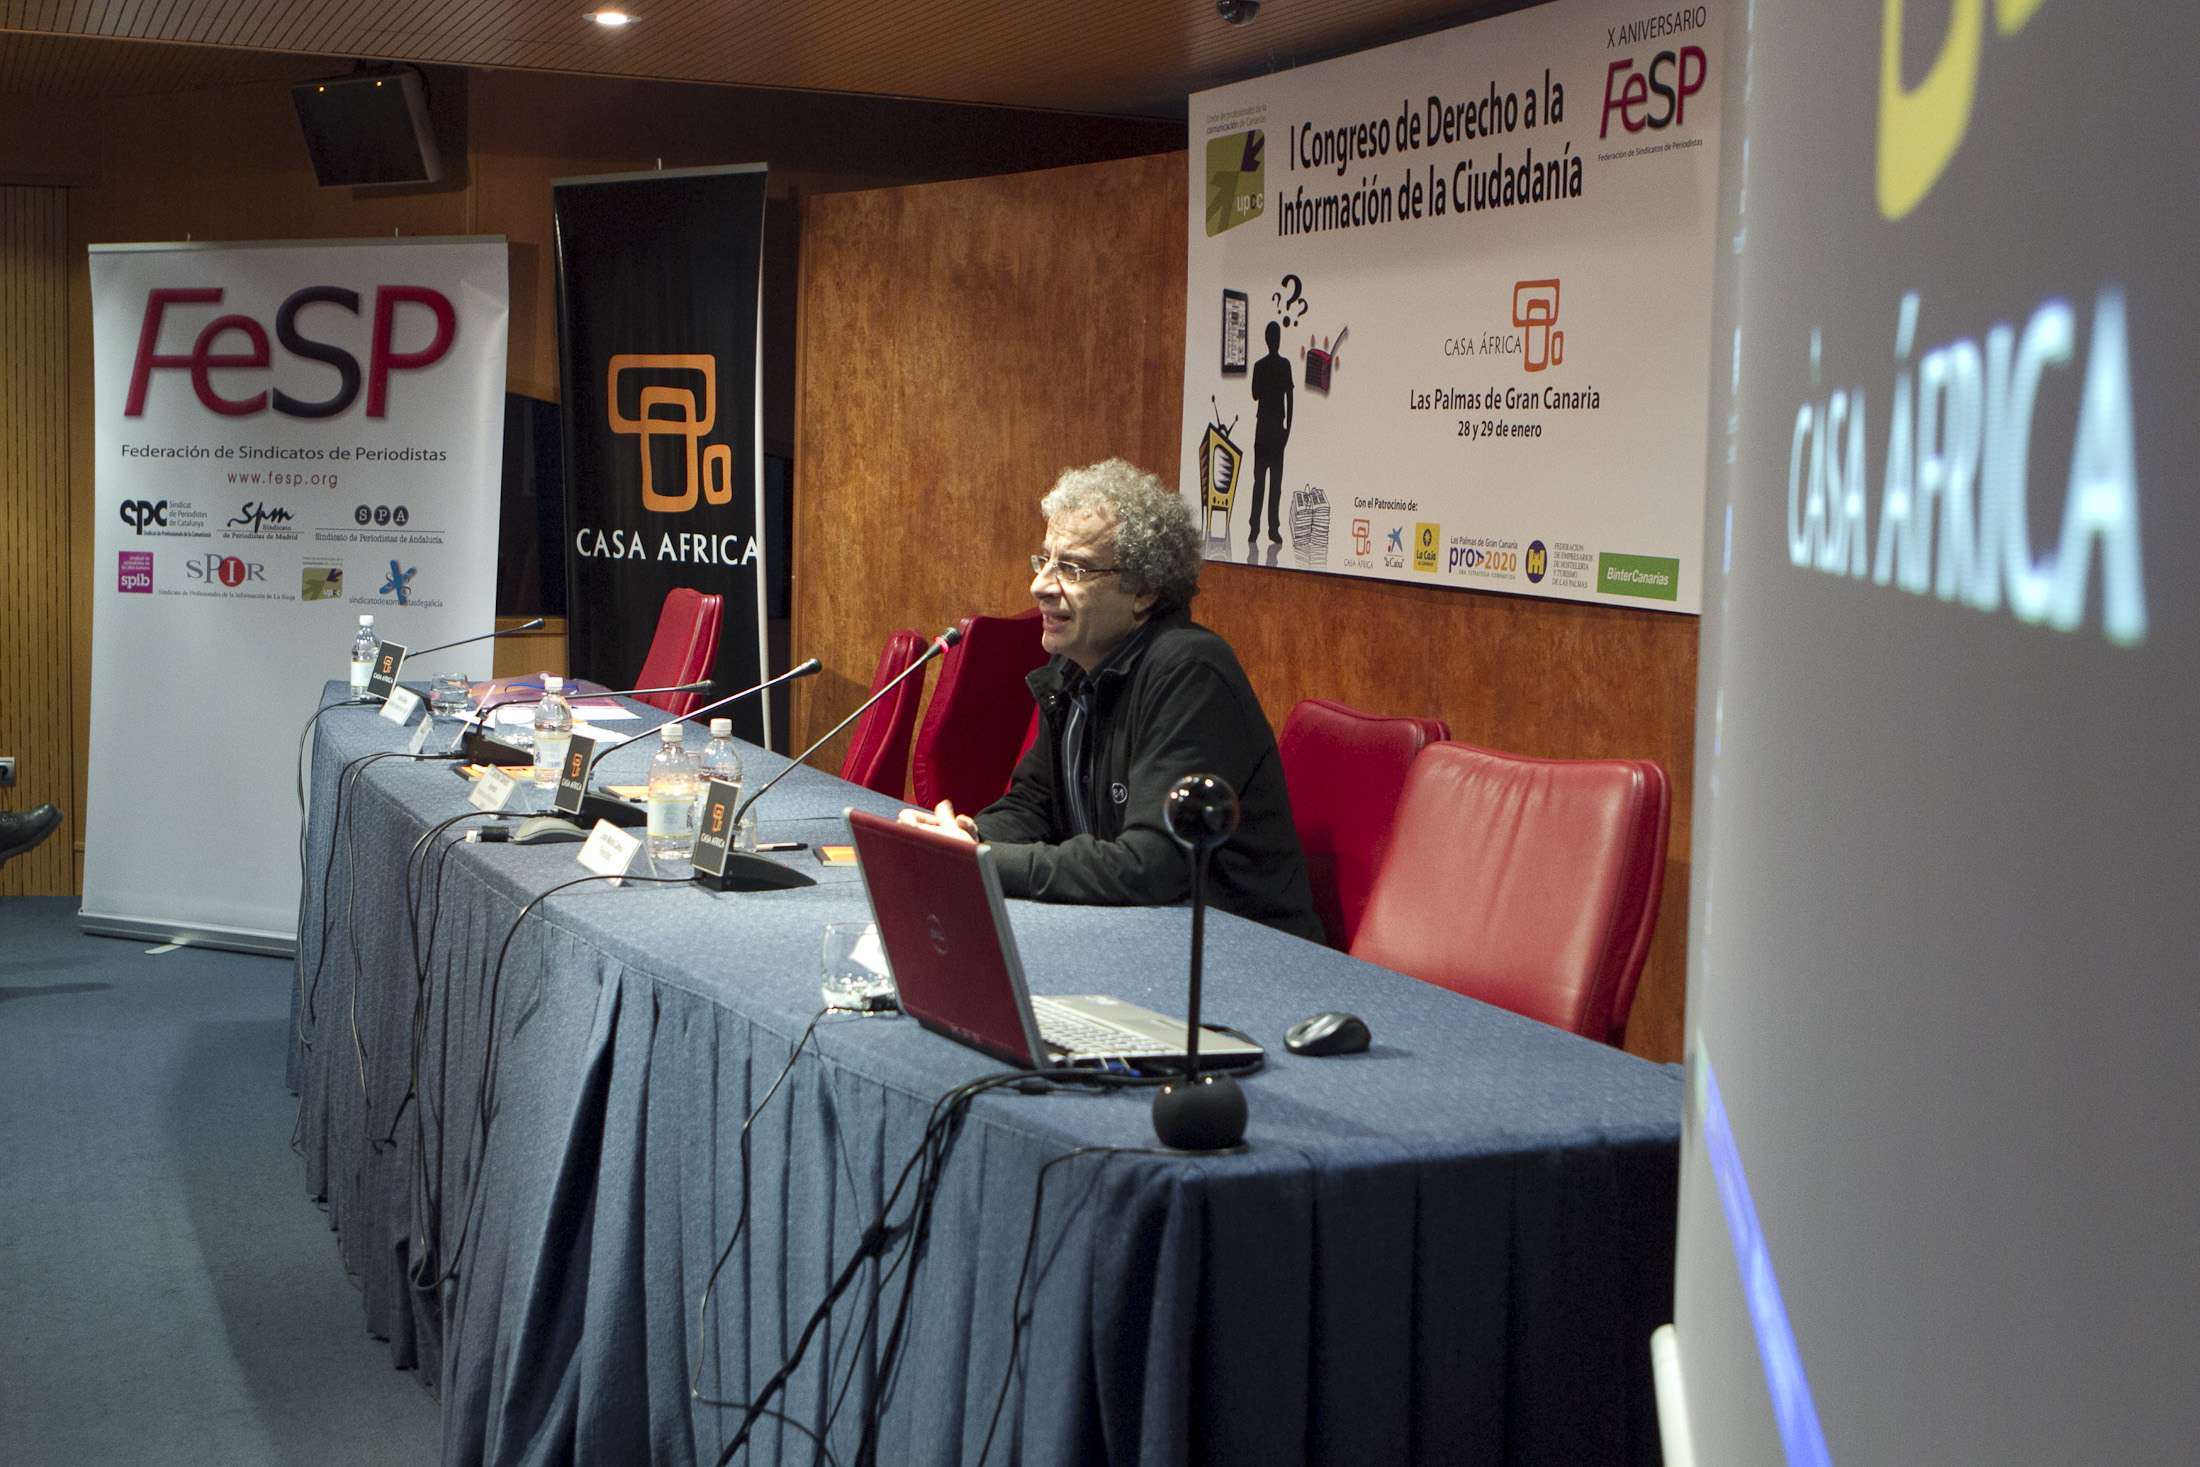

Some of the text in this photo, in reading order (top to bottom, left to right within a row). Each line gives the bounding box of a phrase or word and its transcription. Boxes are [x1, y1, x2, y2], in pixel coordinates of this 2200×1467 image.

[1606, 6, 1707, 48] X ANIVERSARIO
[1599, 45, 1707, 139] FeSP
[1290, 68, 1564, 177] I Congreso de Derecho a la
[1628, 149, 1635, 157] de
[1636, 145, 1663, 155] Sindicatos
[1664, 143, 1671, 151] de
[1672, 139, 1703, 149] Periodistas
[1278, 141, 1583, 237] Información de la Ciudadanía
[123, 284, 457, 419] FeSP
[1444, 332, 1522, 356] CASA ÁFRICA
[1410, 385, 1600, 410] Las Palmas de Gran Canaria
[1457, 419, 1542, 441] 28 y 29 de enero
[121, 443, 447, 461] Federación de Sindicatos de Periodistas
[227, 470, 338, 489] www.fesp.org
[169, 501, 192, 509] Sindicat
[1354, 496, 1418, 511] Con el Patrocinio de:
[169, 510, 207, 519] de Periodistes
[169, 519, 204, 529] de Catalunya
[262, 523, 291, 531] Sindicato
[232, 532, 264, 540] Periodistas
[315, 532, 348, 541] Sindicato
[349, 533, 357, 542] de
[359, 533, 398, 543] Periodistas
[400, 535, 407, 543] de
[1450, 535, 1459, 545] Las
[1460, 536, 1477, 546] Palmas
[1478, 537, 1484, 547] de
[1485, 538, 1497, 548] Gran
[576, 527, 758, 566] CASA AFRICA
[1344, 558, 1356, 568] CASA
[1553, 560, 1560, 568] DE
[1554, 551, 1594, 562] DE EMPRESARIOS
[121, 573, 150, 589] spib
[1557, 569, 1578, 579] TURISMO
[1606, 566, 1669, 586] BinterCanarias
[1552, 577, 1588, 589] DE LAS PALMAS
